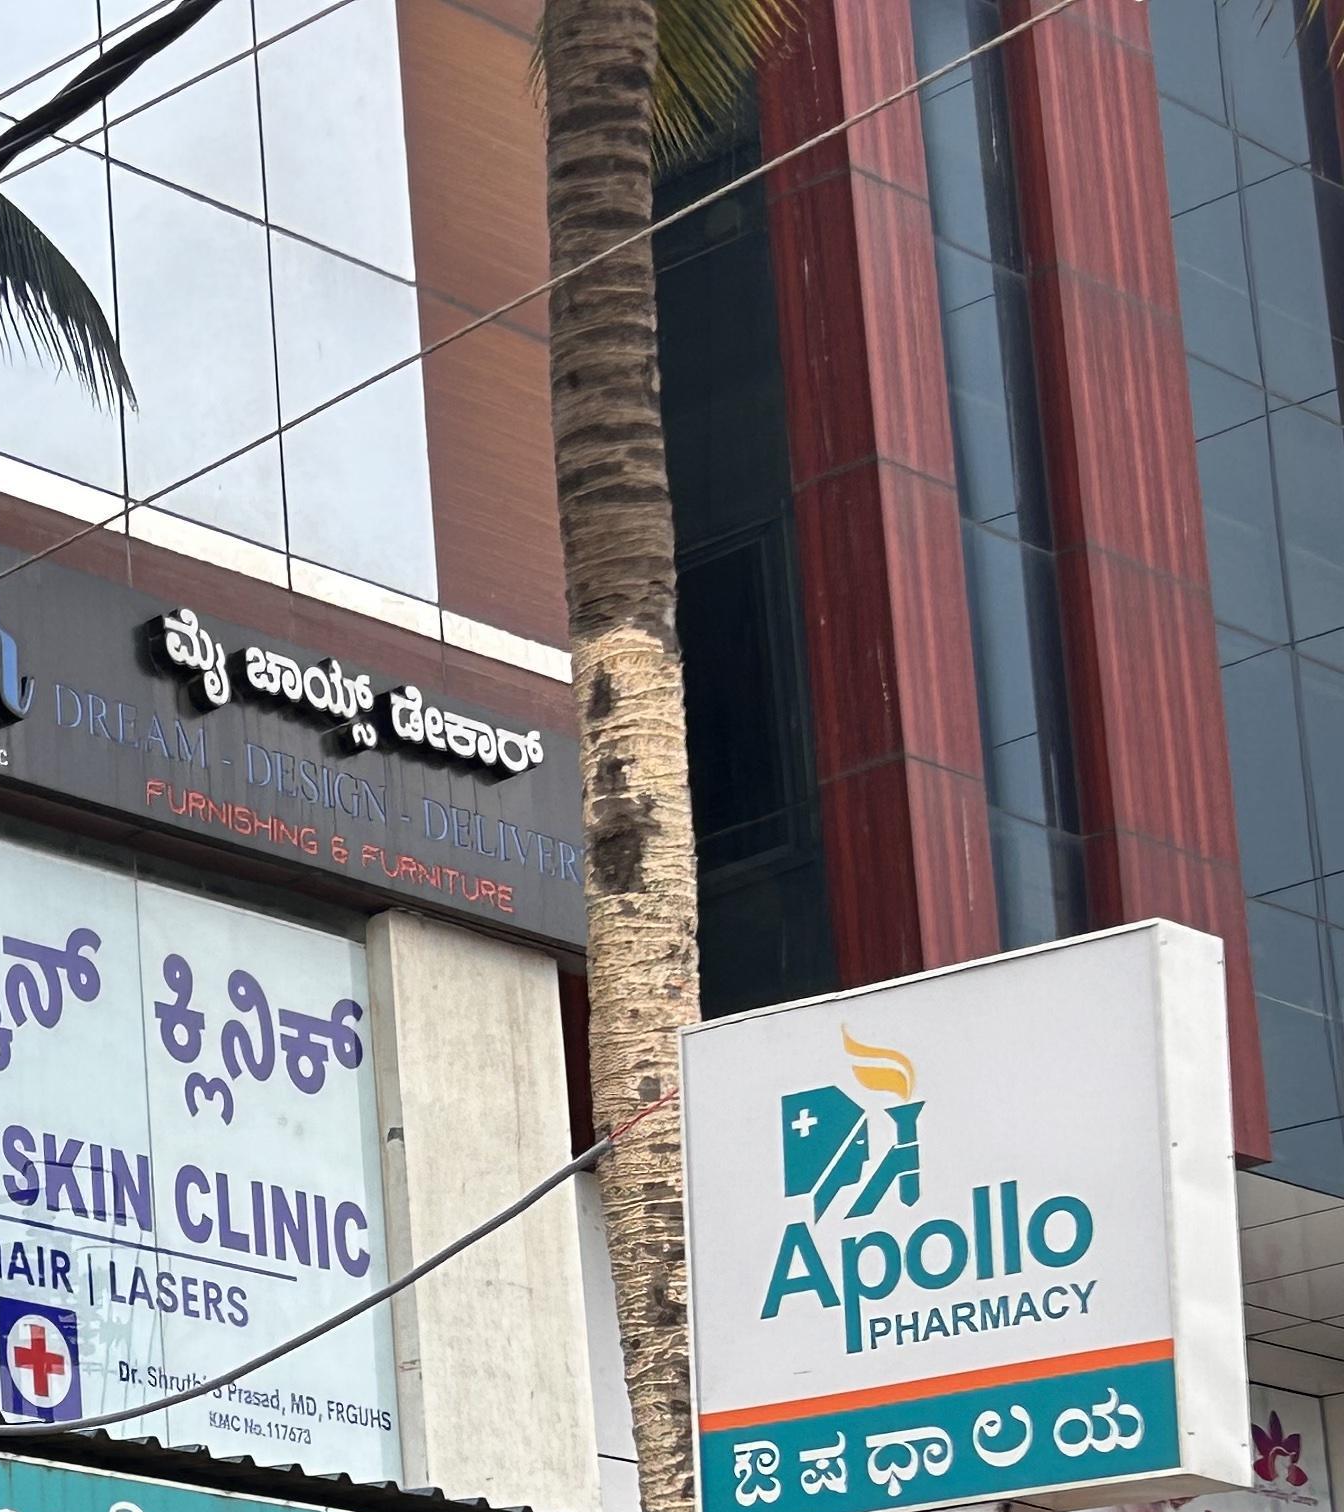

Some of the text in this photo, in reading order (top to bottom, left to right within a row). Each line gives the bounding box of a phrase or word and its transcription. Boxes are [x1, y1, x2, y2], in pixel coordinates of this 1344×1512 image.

[54, 683, 584, 887] DREAM DESIGN DELIVER
[145, 779, 514, 913] FURNISHING & FURNITURE
[1, 1122, 154, 1233] SKIN
[174, 1164, 372, 1279] CLINIC
[759, 1179, 1095, 1355] Apollo
[110, 1258, 250, 1329] LASERS
[868, 1280, 1098, 1350] PHARMACY
[118, 1360, 142, 1385] Dr.
[228, 1383, 286, 1415] Prasad,
[291, 1393, 322, 1423] MD,
[327, 1400, 392, 1431] FRGUHS
